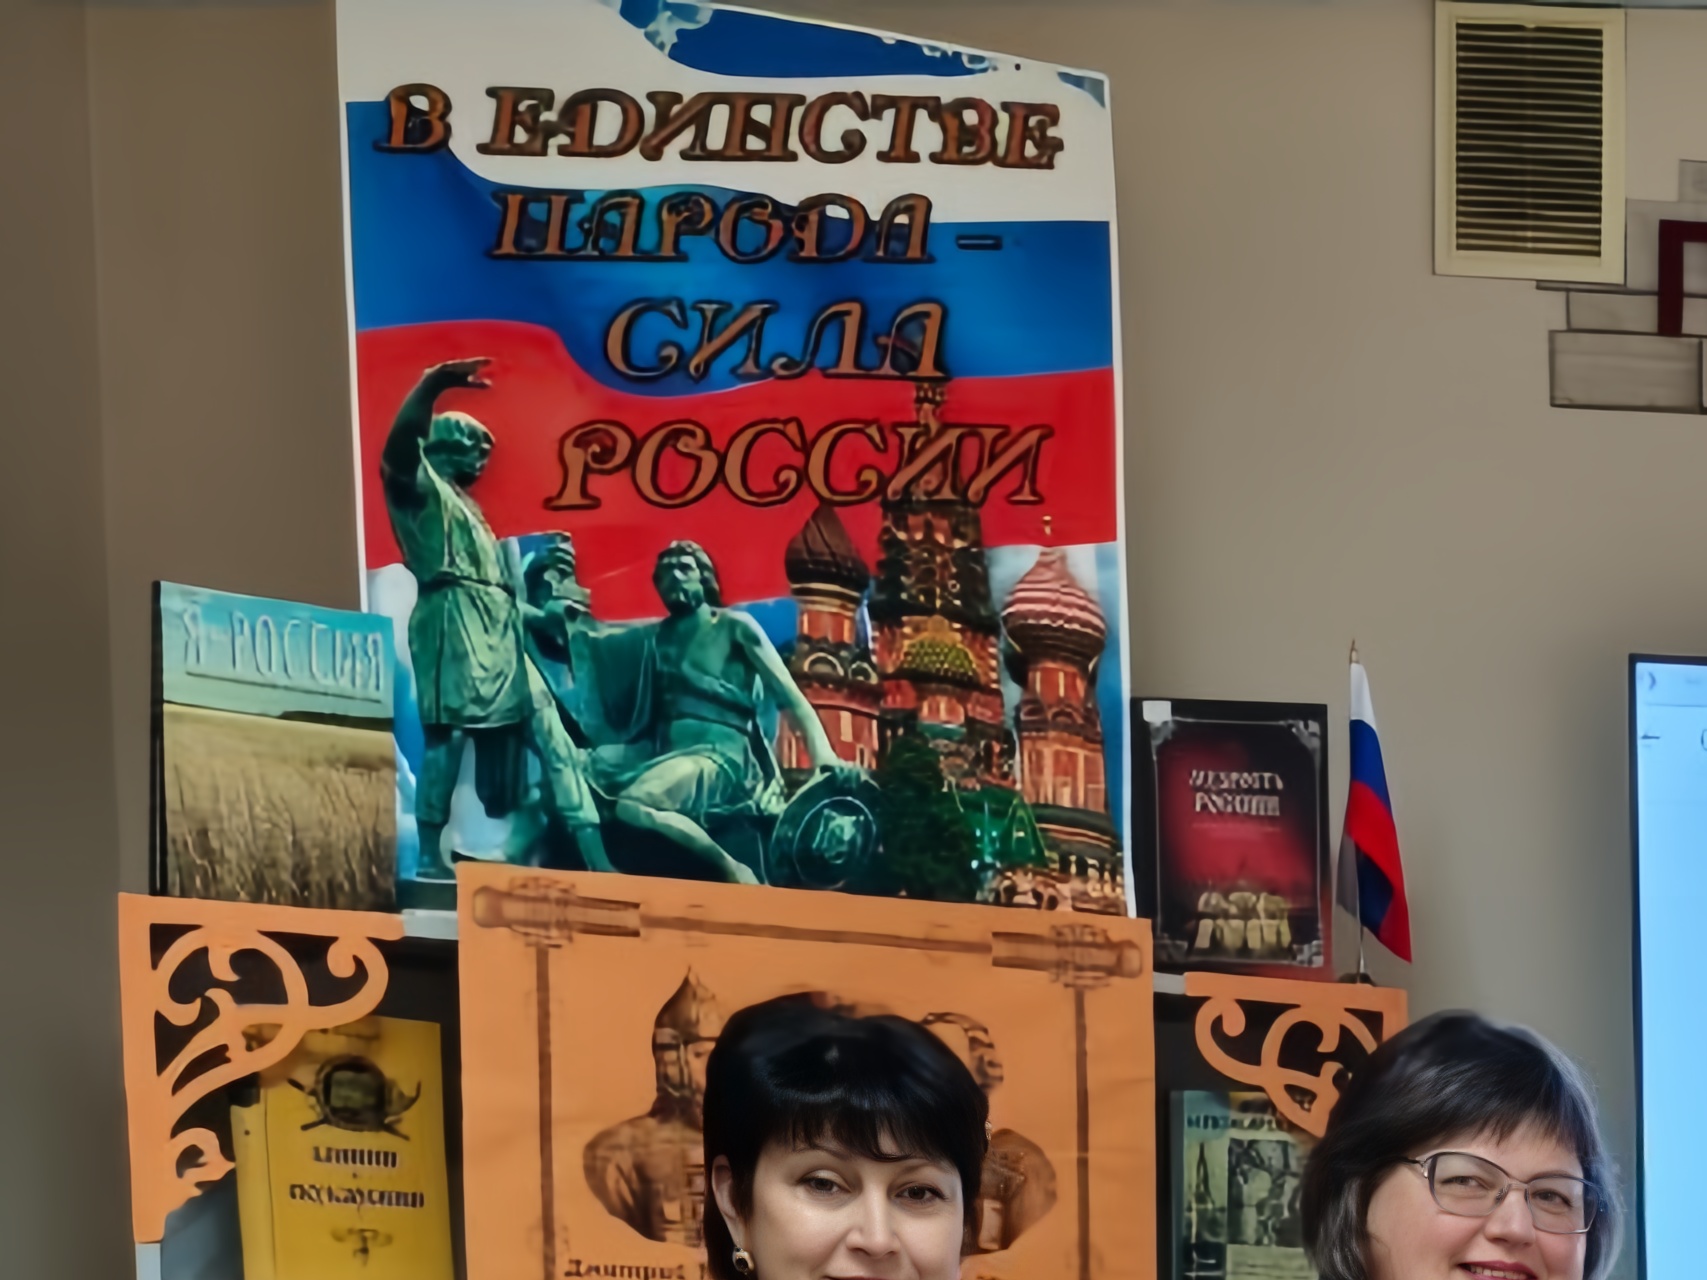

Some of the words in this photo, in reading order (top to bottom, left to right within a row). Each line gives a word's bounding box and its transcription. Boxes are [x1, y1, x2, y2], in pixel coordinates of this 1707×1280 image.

[374, 82, 452, 153] В
[478, 86, 1064, 170] ЕДИНСТВЕ
[487, 190, 935, 264] НАРОДА
[605, 299, 950, 381] СИЛА
[544, 418, 1052, 511] РОССИИ
